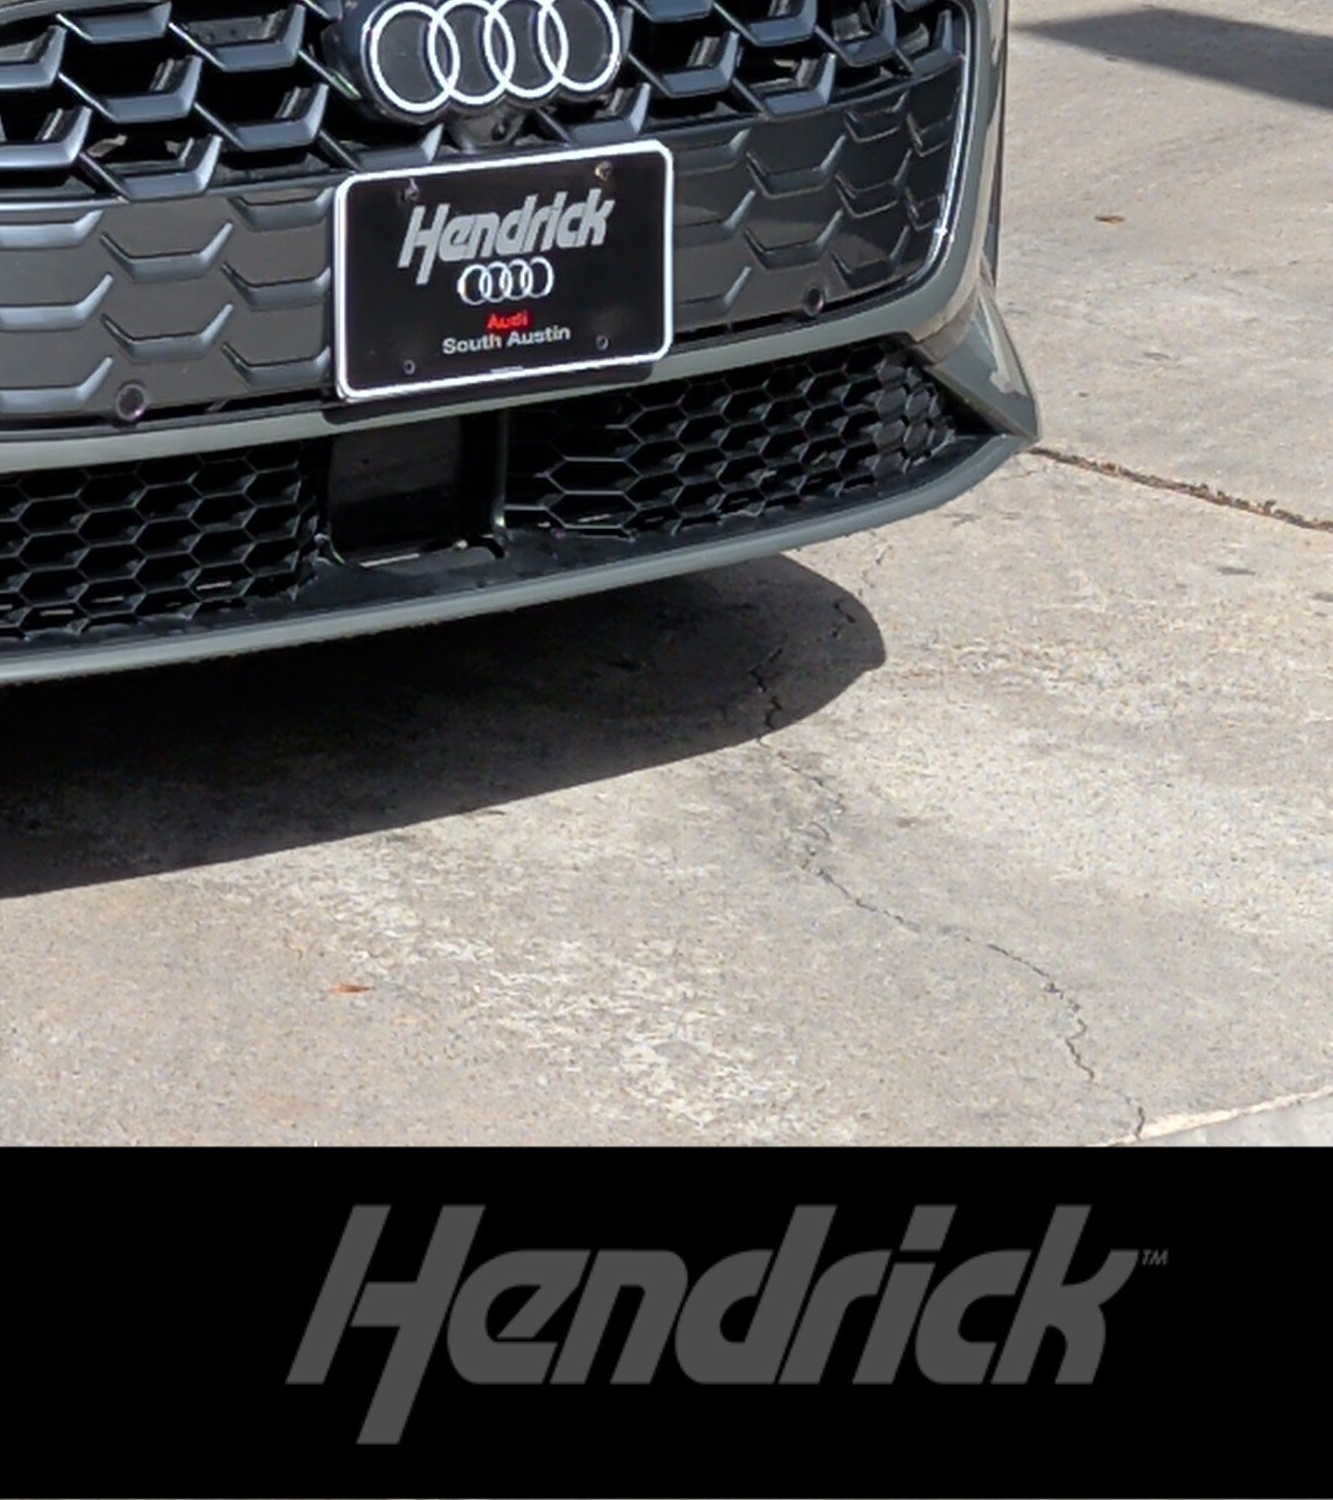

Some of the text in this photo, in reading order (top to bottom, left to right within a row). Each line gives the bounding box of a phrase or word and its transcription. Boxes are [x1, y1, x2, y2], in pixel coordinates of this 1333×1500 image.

[397, 188, 615, 285] Hendrick
[487, 310, 529, 329] Audi
[442, 325, 572, 355] South Austin
